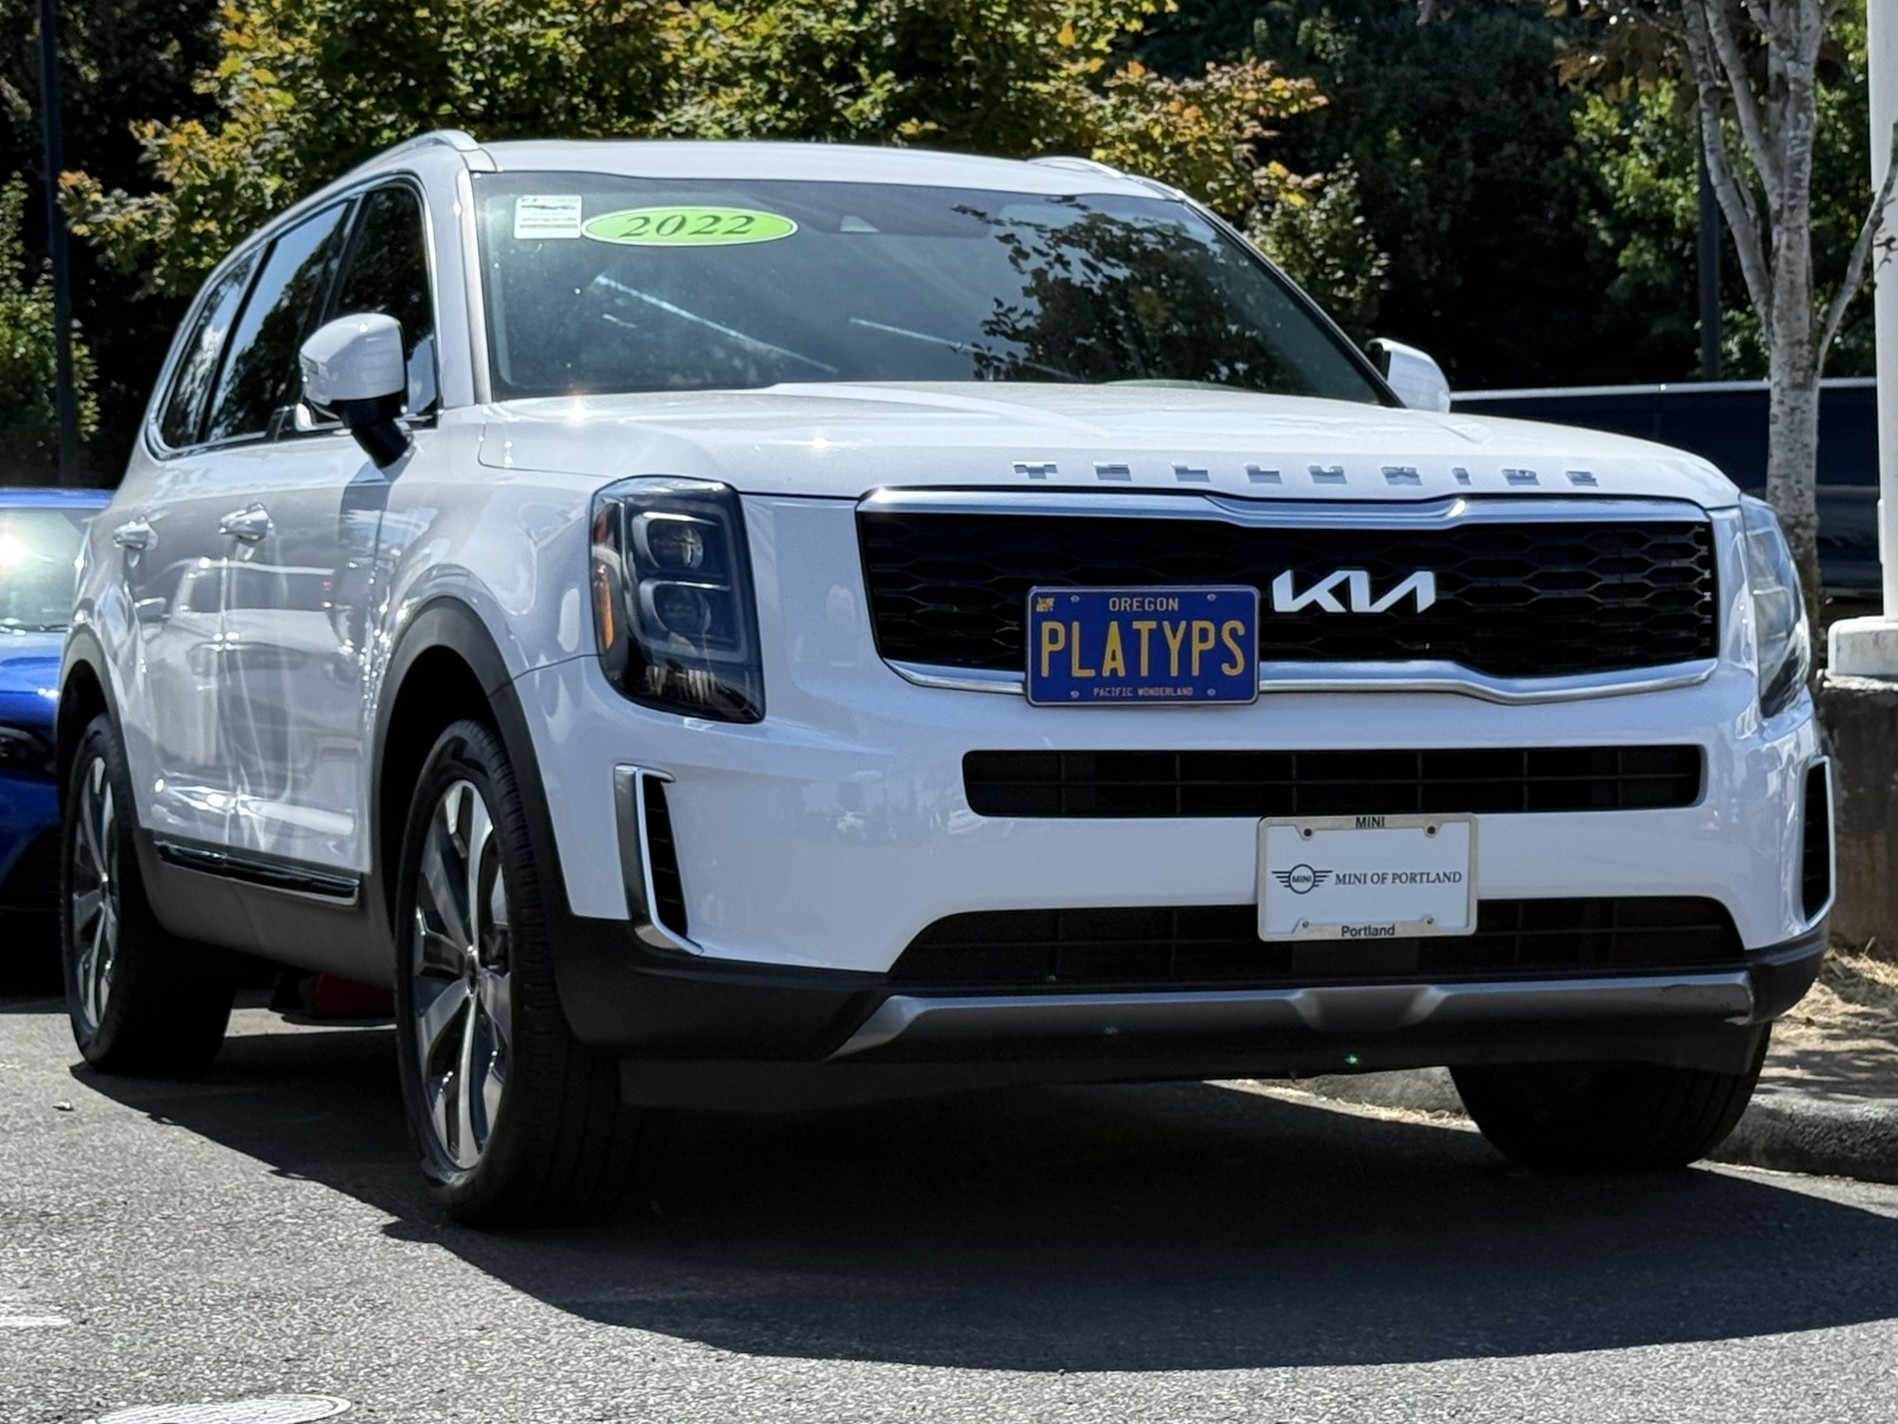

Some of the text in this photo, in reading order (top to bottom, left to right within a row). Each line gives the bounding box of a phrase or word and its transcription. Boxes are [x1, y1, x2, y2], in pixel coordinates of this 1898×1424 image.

[618, 214, 757, 238] 2022
[1011, 460, 1600, 488] TELLURIDE
[1271, 568, 1437, 615] KIA
[1108, 597, 1179, 612] OREGON
[1040, 619, 1246, 678] PLATYPS
[1093, 686, 1194, 698] PACIFIC WONDERLAND
[1354, 815, 1386, 829] MINI
[1291, 874, 1313, 884] MINI
[1334, 870, 1463, 886] MINI OF PORTLAND
[1340, 924, 1396, 938] Portland
